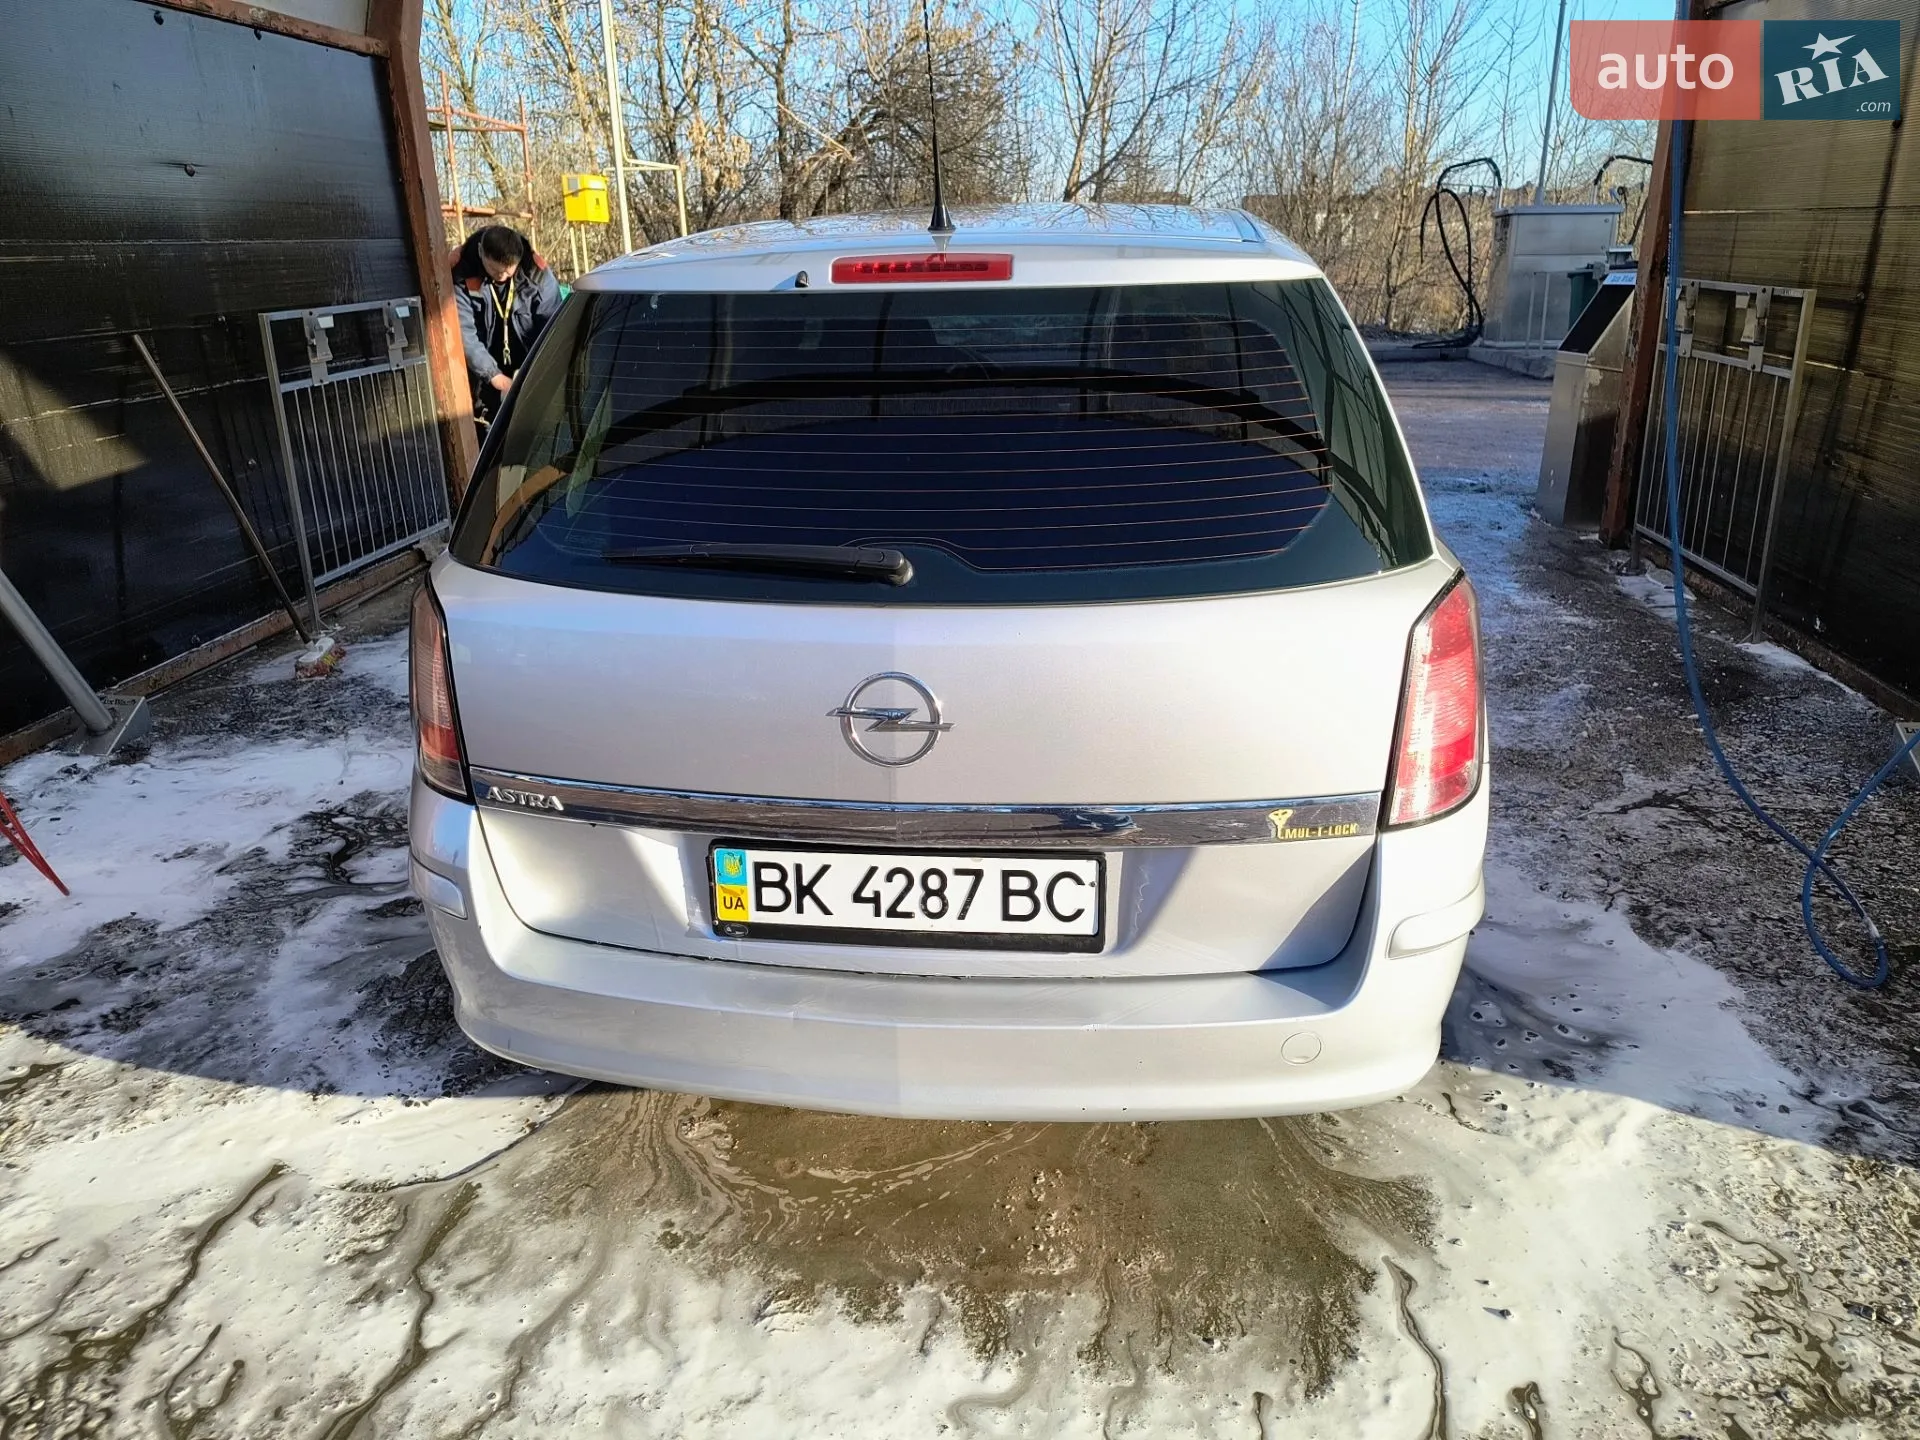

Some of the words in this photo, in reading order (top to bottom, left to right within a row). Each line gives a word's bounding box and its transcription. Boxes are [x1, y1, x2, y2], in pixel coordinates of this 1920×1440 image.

[486, 786, 564, 811] ASTRA
[722, 896, 745, 911] UA
[753, 861, 834, 916] BK
[852, 865, 985, 921] 4287
[1001, 869, 1086, 923] BC
